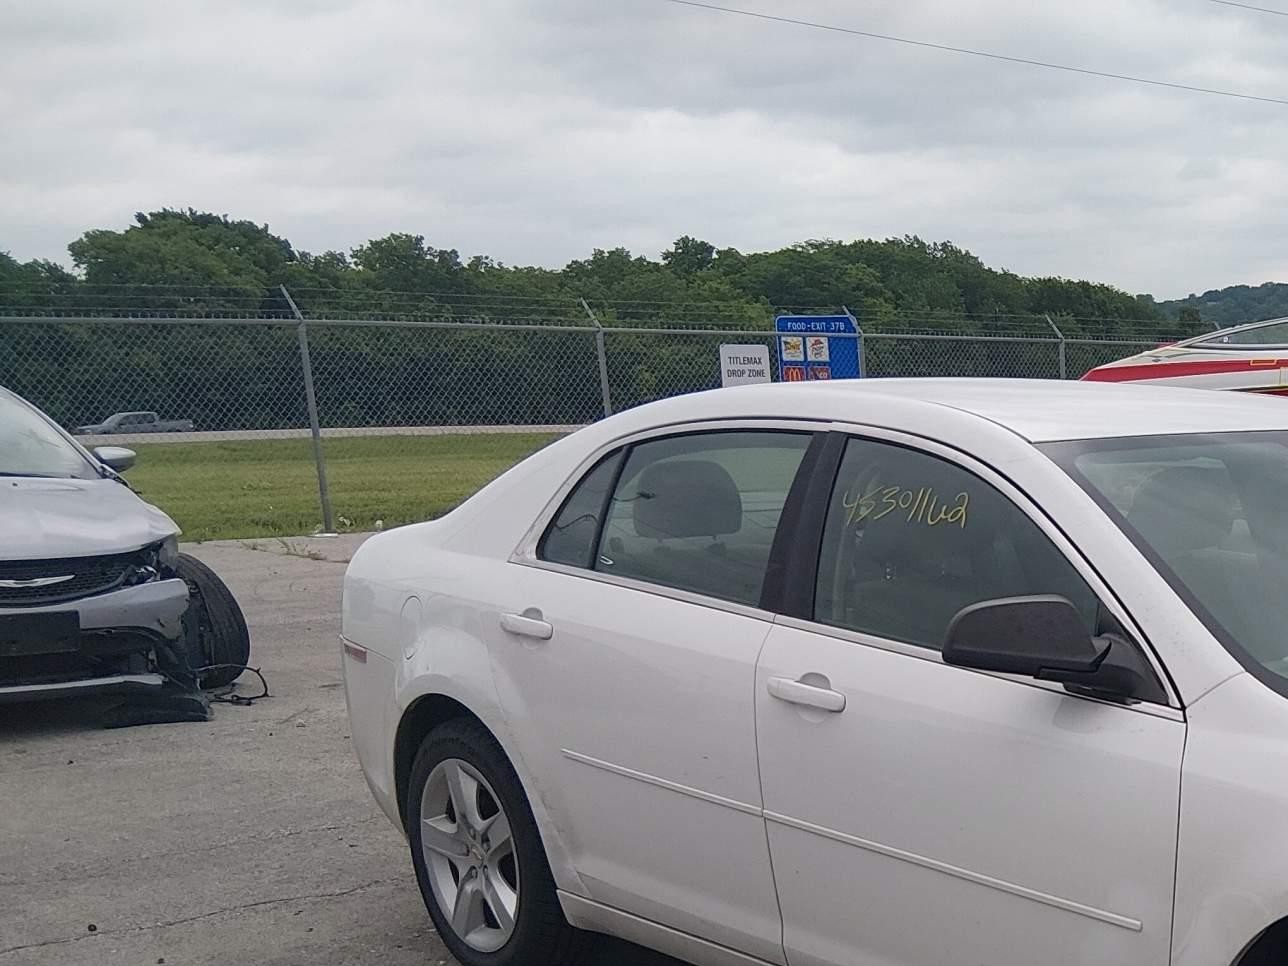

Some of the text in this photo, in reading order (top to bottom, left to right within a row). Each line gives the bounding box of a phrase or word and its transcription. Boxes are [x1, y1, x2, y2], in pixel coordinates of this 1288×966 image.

[787, 321, 807, 331] FOOD
[727, 356, 763, 366] TITLEMAX
[727, 369, 767, 378] DROP ZONE
[842, 485, 969, 529] 45301162
